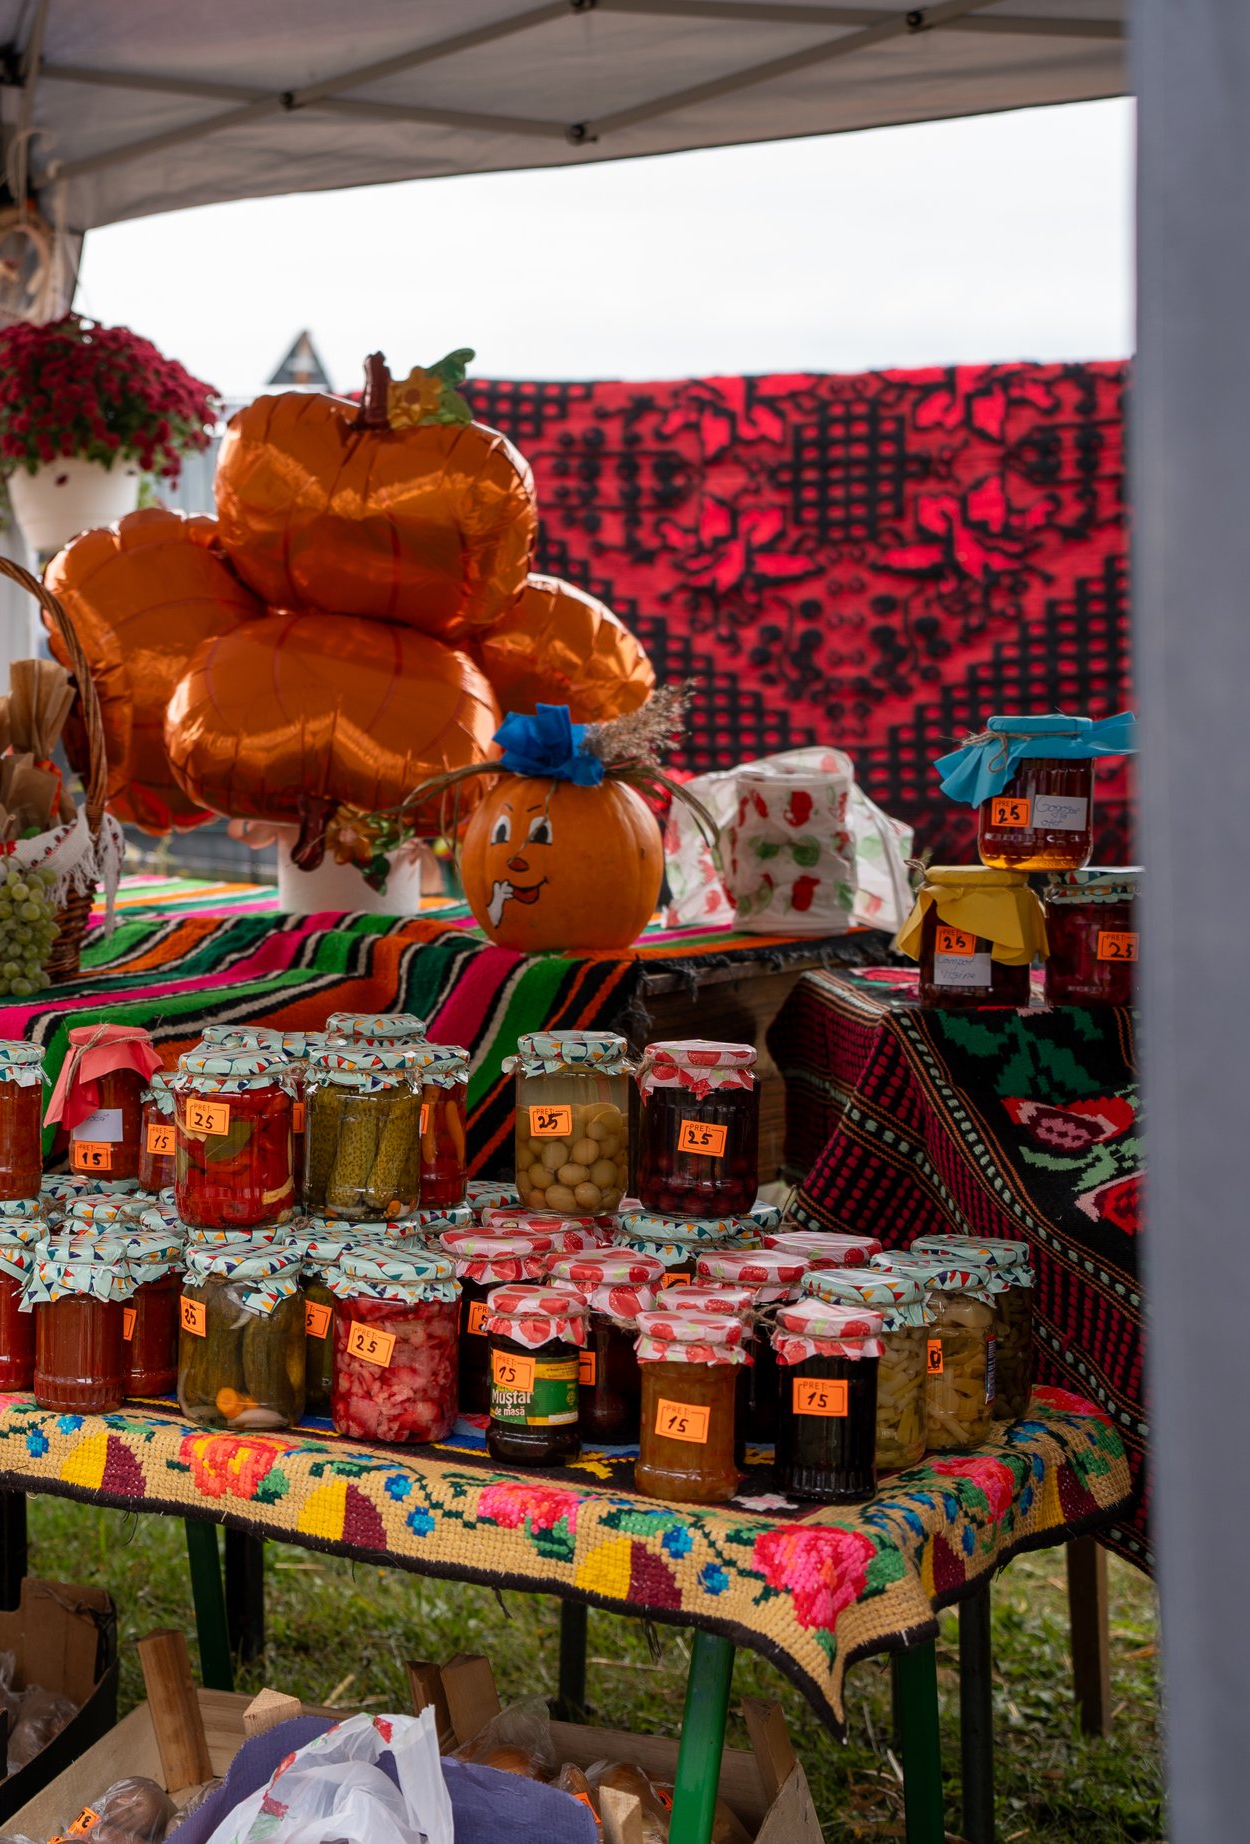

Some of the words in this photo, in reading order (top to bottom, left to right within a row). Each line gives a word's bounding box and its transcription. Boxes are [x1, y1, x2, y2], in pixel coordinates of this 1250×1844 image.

[998, 804, 1020, 824] 25
[943, 935, 966, 950] 25
[1109, 942, 1134, 958] 25
[194, 1112, 214, 1129] 25
[537, 1113, 563, 1130] 25
[154, 1135, 169, 1149] 15
[688, 1130, 713, 1145] 25
[82, 1152, 102, 1166] 15
[184, 1303, 197, 1326] 25
[355, 1334, 378, 1354] 25
[498, 1365, 517, 1383] 15
[807, 1391, 829, 1408] 15
[494, 1406, 502, 1416] de
[668, 1415, 690, 1433] 15
